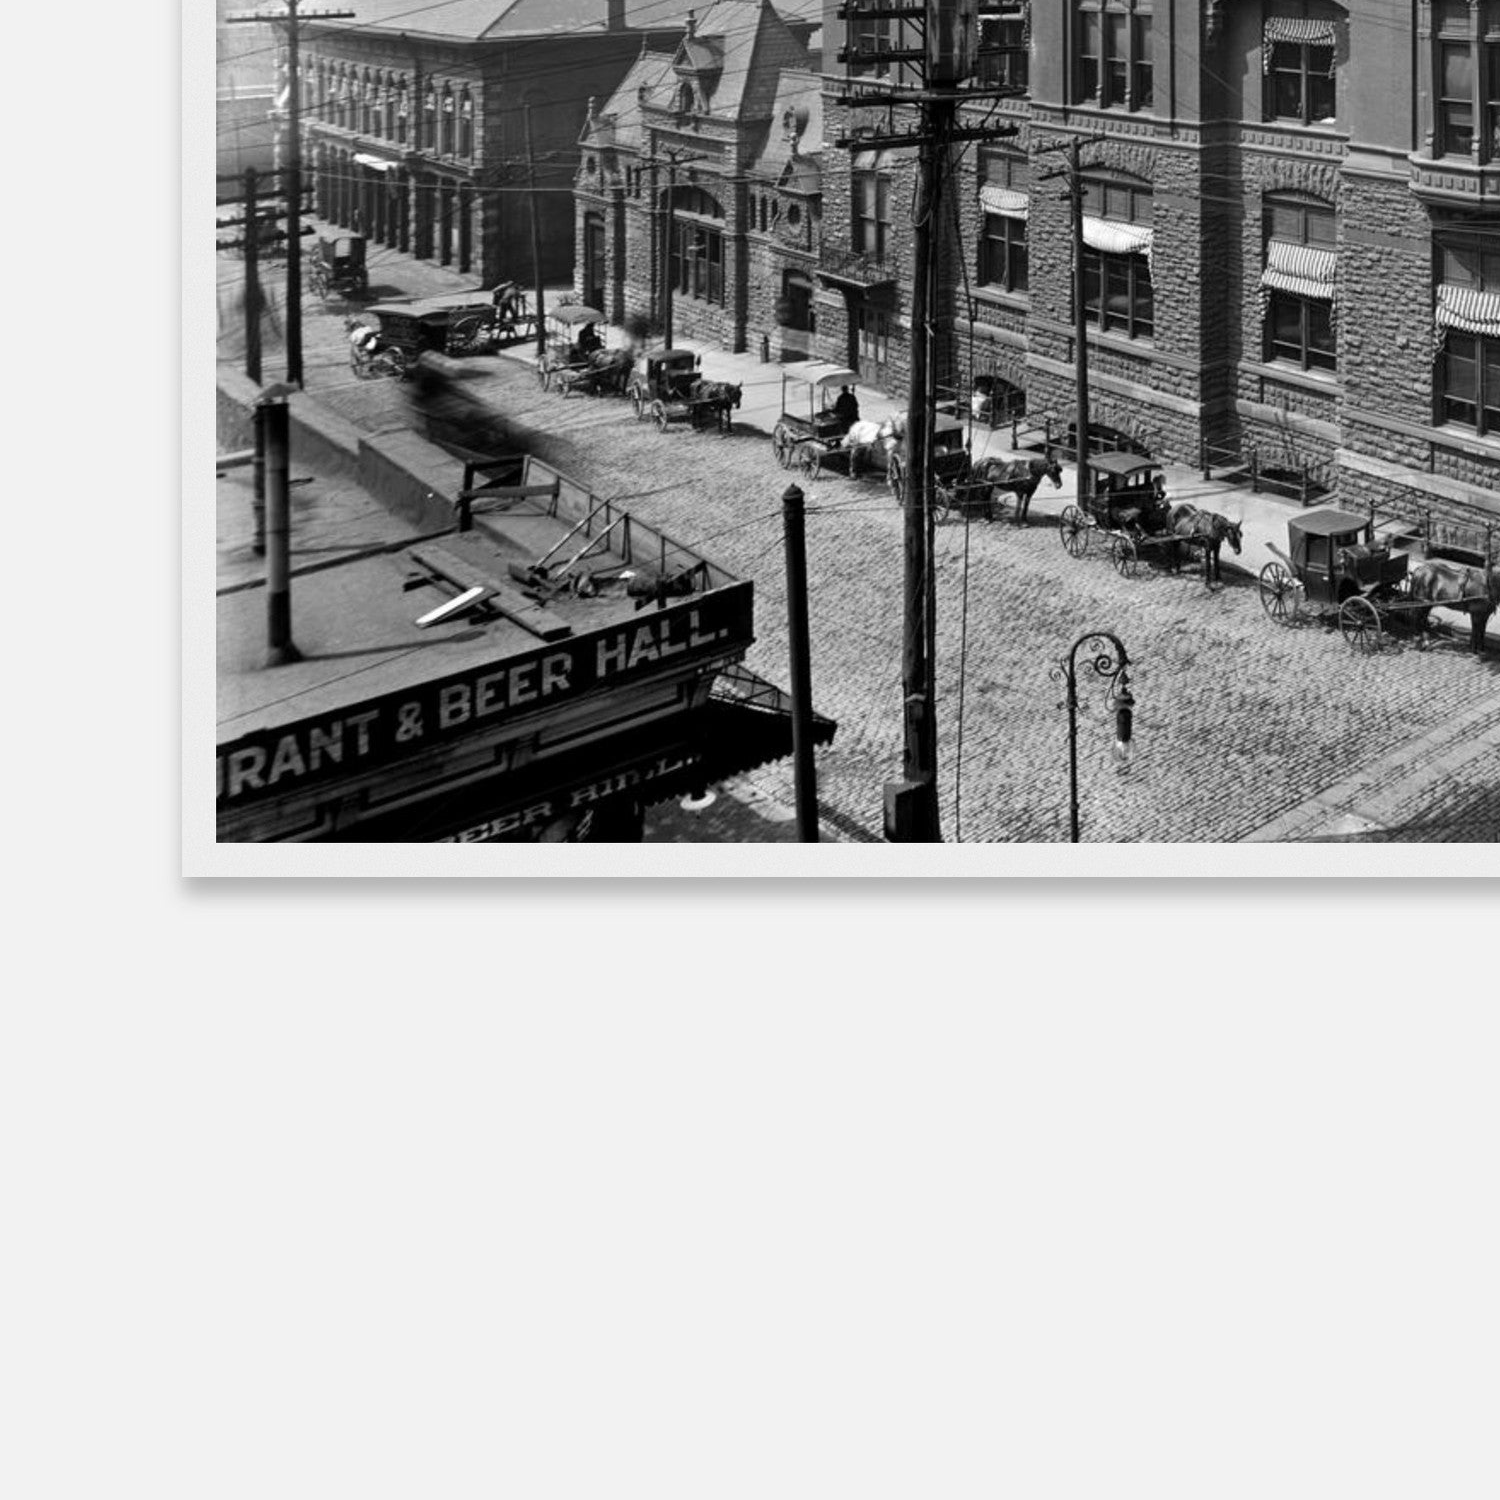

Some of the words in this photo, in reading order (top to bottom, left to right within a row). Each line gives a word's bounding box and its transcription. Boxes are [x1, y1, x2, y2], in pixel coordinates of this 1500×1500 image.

[396, 702, 424, 743] &
[440, 653, 573, 729] BEER
[597, 610, 729, 678] HALL.
[437, 802, 552, 843] EER
